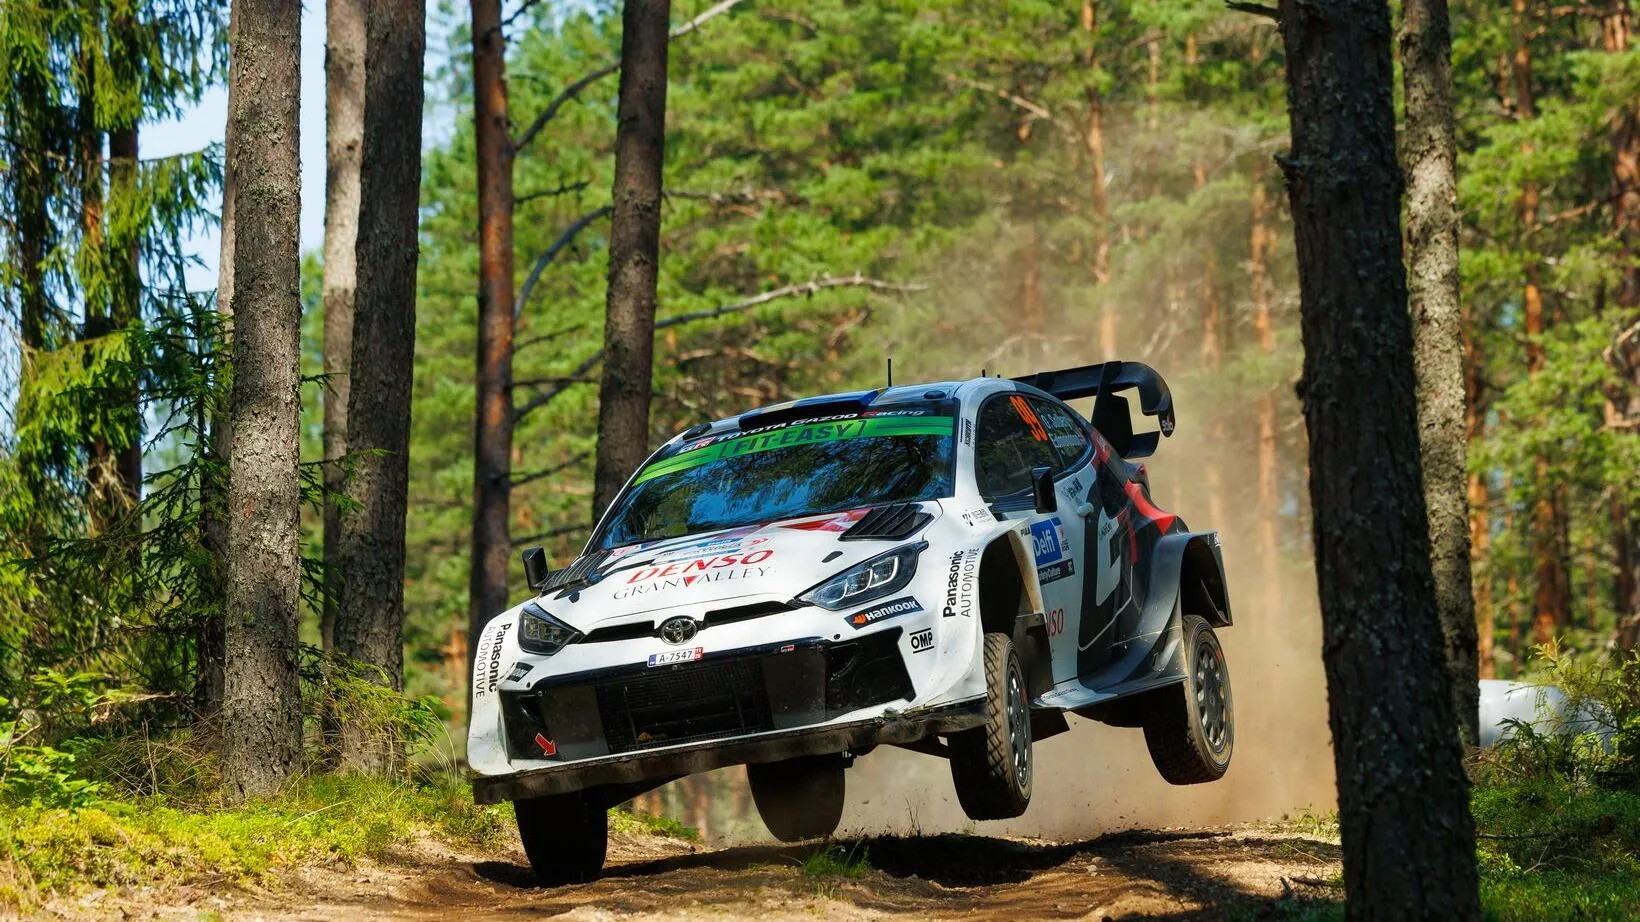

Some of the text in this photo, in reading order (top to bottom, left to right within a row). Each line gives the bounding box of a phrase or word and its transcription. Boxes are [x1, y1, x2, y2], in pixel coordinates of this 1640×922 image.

[717, 422, 787, 442] TOYOTA
[792, 413, 858, 427] GAZOO
[860, 410, 925, 419] Racing
[1032, 529, 1056, 557] Delfi
[627, 549, 774, 584] DENSO
[943, 550, 964, 618] Panasonic
[961, 548, 980, 618] AUTOMOTIVE
[489, 623, 512, 693] Panasonic
[659, 651, 693, 663] A-7547
[910, 632, 933, 650] OMP
[475, 626, 497, 698] AUTOMOTIVE
